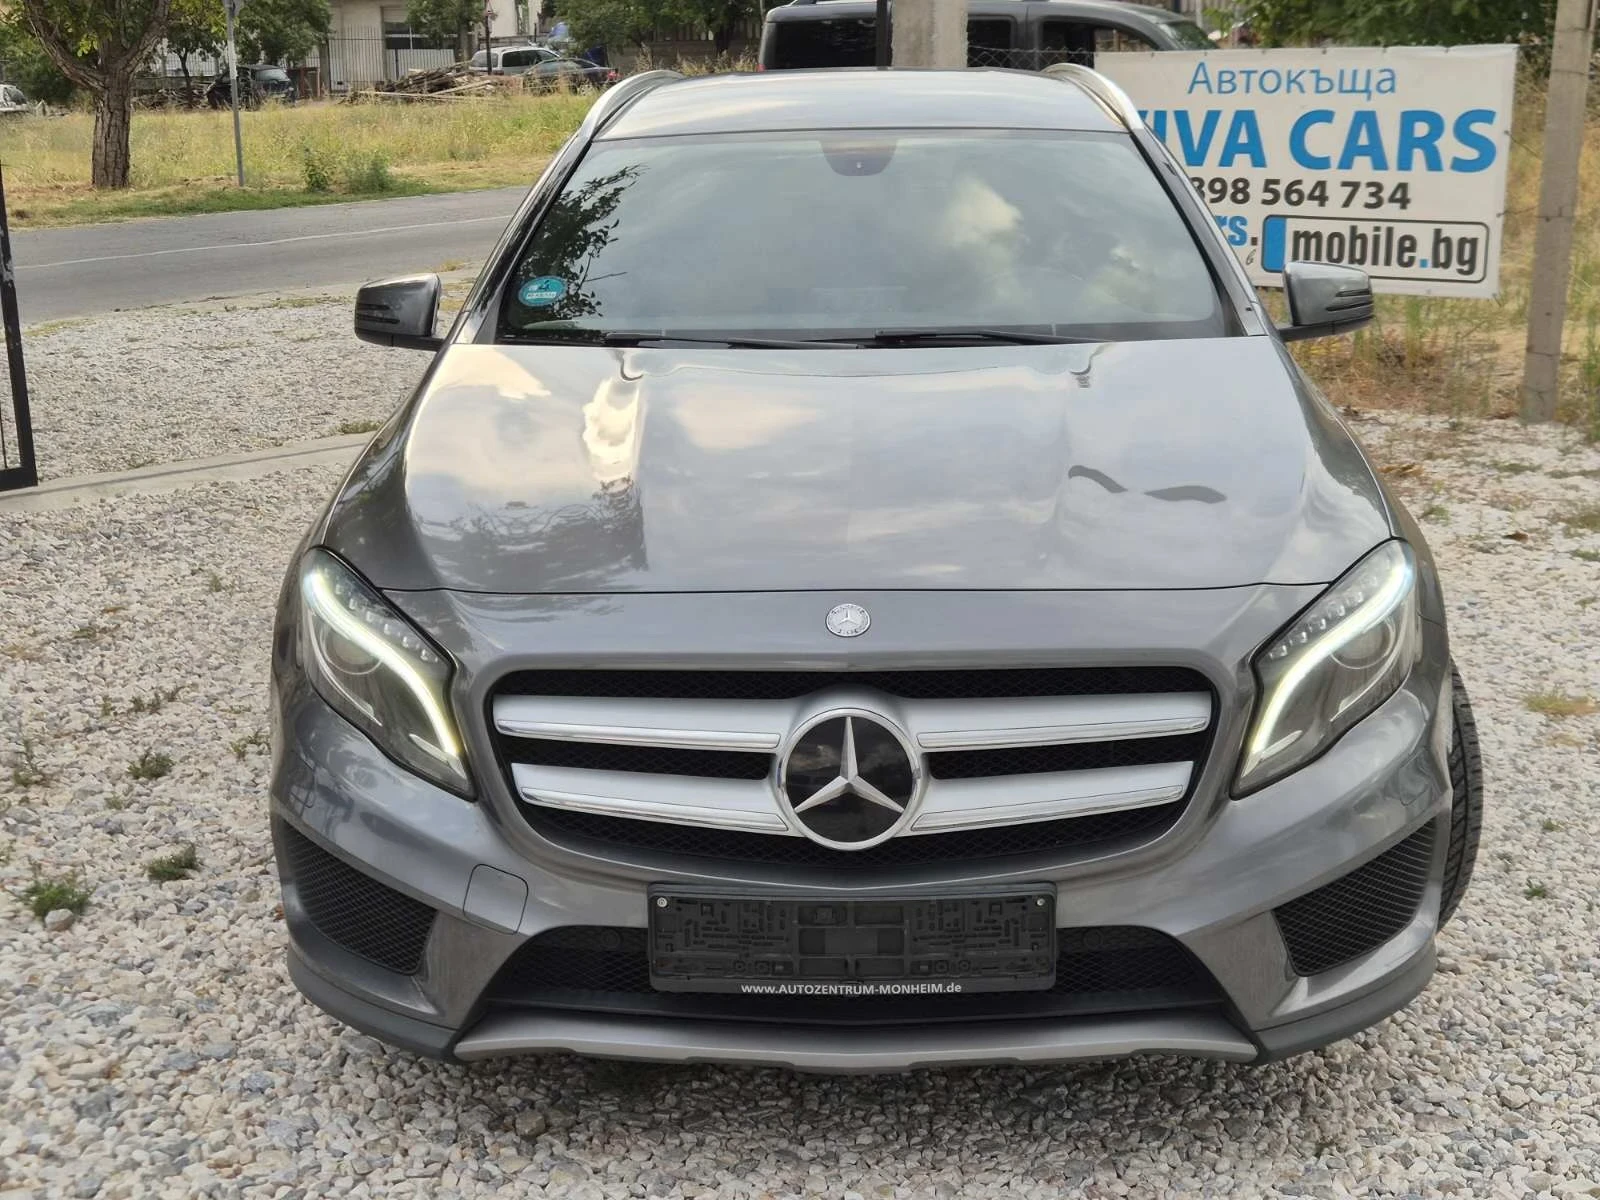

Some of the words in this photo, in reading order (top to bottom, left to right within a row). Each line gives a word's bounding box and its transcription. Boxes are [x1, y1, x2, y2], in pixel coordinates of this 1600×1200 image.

[1188, 61, 1397, 100] Автокъща
[1138, 109, 1268, 168] IVA
[1289, 108, 1498, 173] CARS
[1260, 178, 1329, 207] 564
[1340, 180, 1412, 210] 734
[1292, 224, 1479, 276] mobile.bg
[741, 981, 962, 995] www.AUTOZENTRUM-MONHEIM.de
